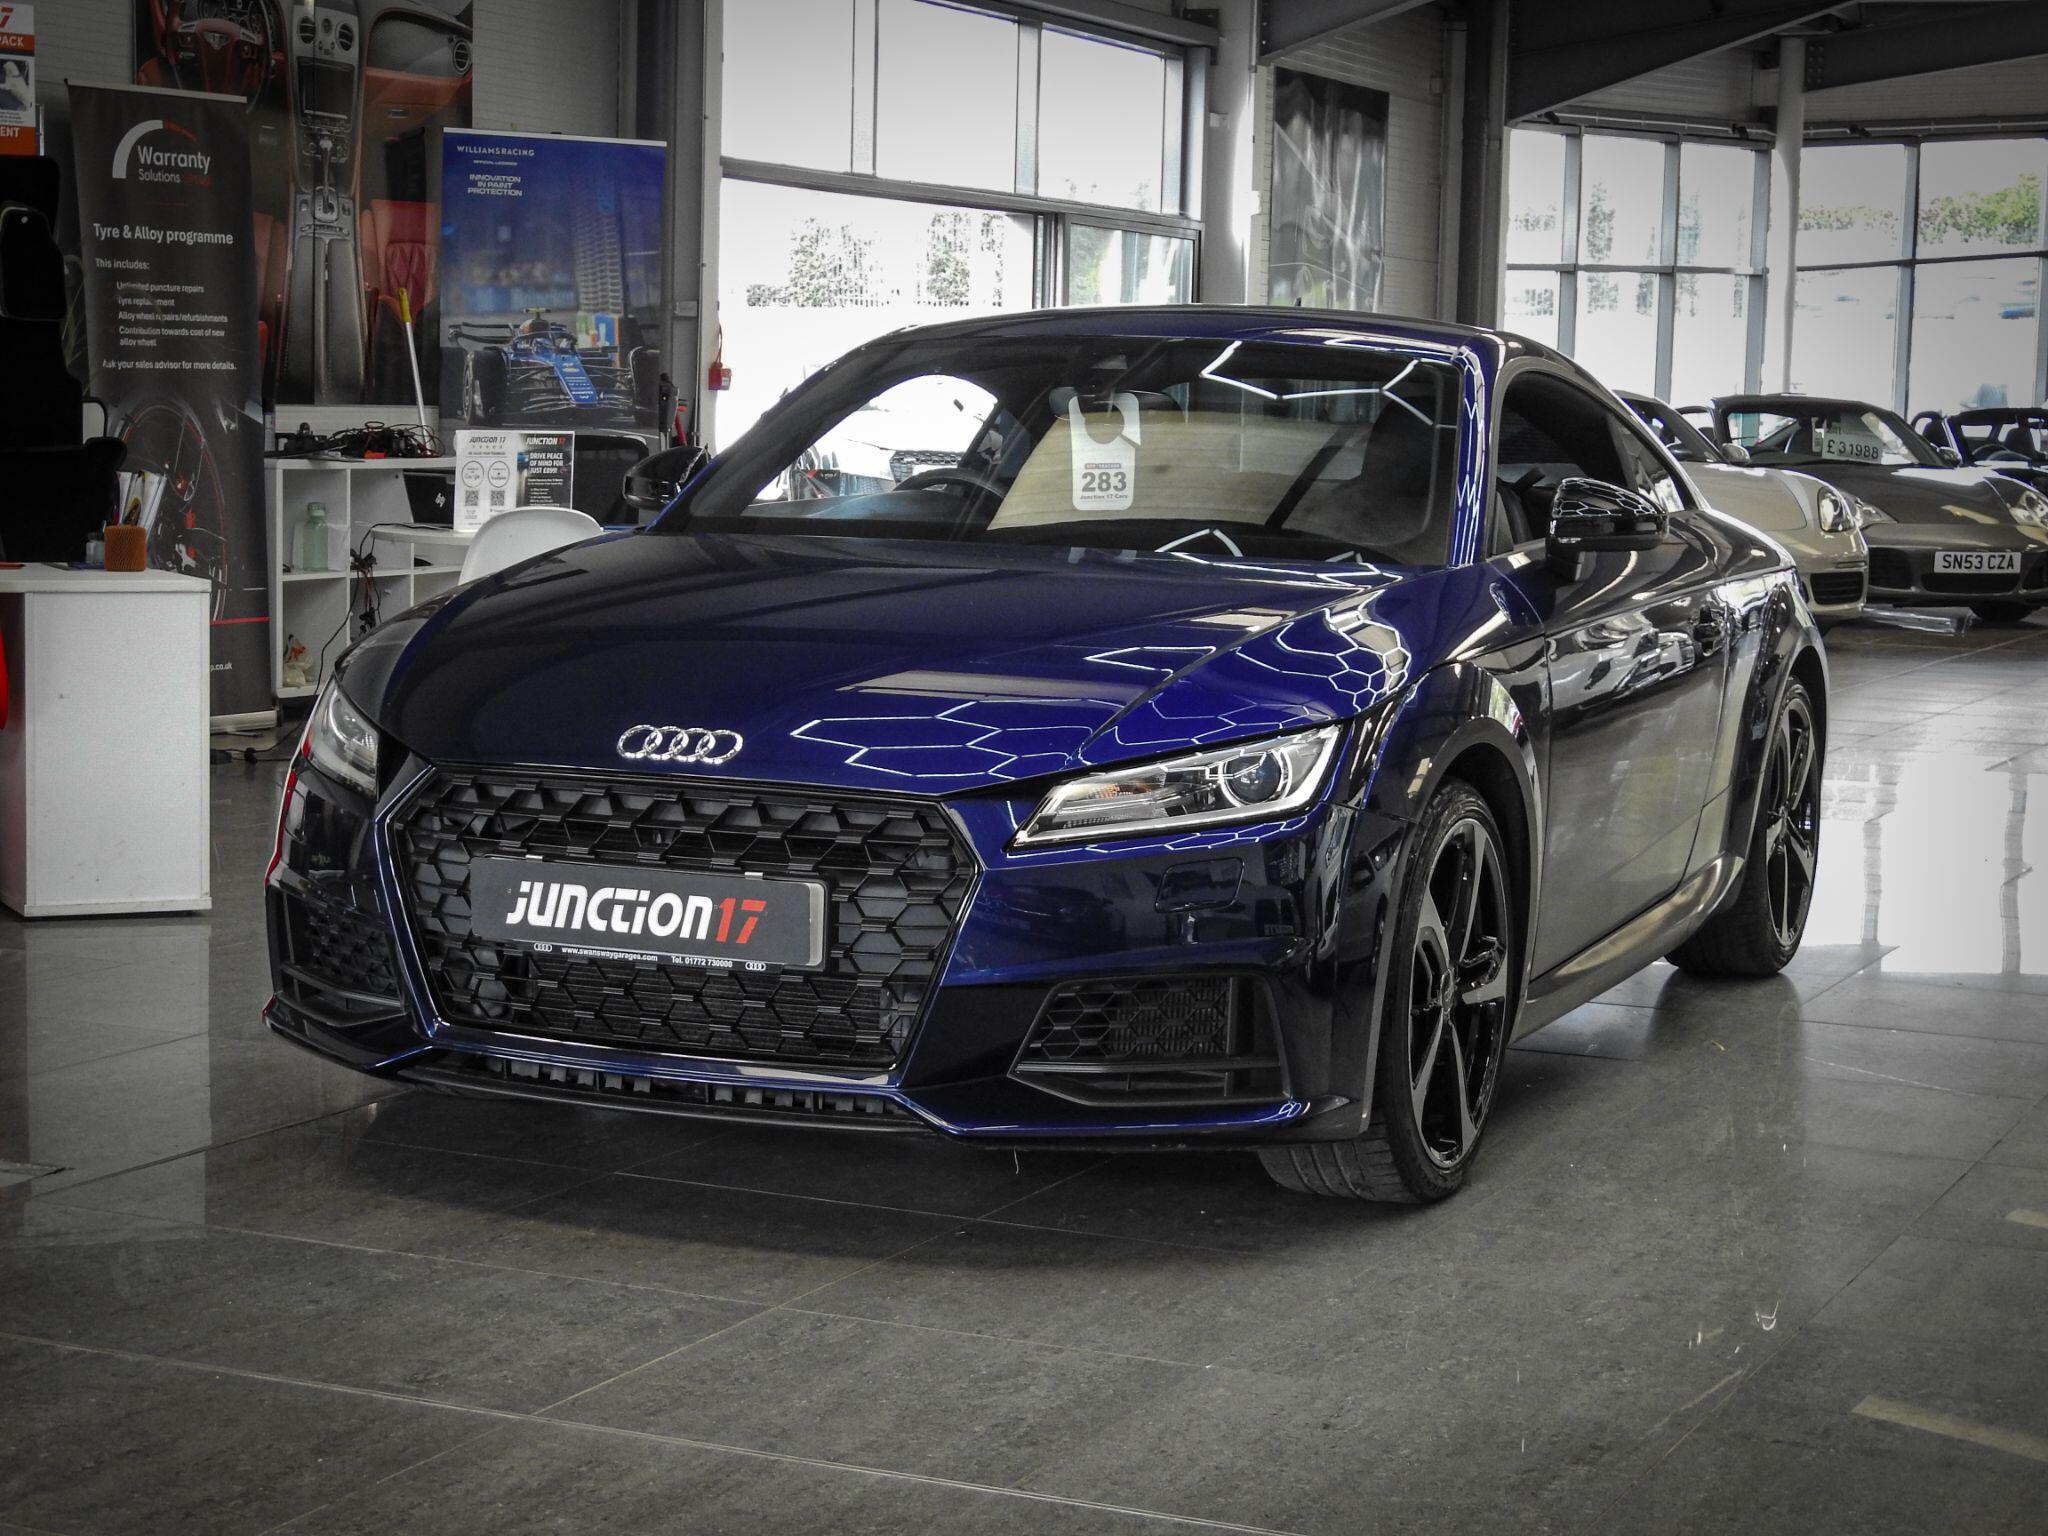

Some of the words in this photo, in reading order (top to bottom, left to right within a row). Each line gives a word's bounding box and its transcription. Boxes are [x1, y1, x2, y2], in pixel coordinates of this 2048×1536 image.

[138, 145, 211, 174] Warranty
[138, 168, 181, 183] Solutions
[469, 174, 521, 183] INNOVATION
[467, 188, 523, 196] PROTECTION
[93, 223, 120, 240] Tyre
[123, 224, 132, 239] &
[135, 226, 164, 243] Alloy
[166, 230, 234, 246] programme
[95, 258, 112, 268] This
[114, 259, 150, 269] includes:
[150, 283, 180, 293] puncture
[182, 283, 204, 294] repairs
[118, 312, 135, 322] Alloy
[136, 313, 155, 321] wheel
[119, 326, 161, 336] Contribution
[161, 328, 189, 336] towards
[190, 329, 204, 337] cost
[120, 338, 136, 347] alloy
[118, 361, 133, 370] your
[135, 360, 153, 369] sales
[154, 361, 182, 370] advisor
[182, 361, 192, 369] for
[193, 362, 211, 370] more
[526, 437, 558, 445] JUNCTION
[1082, 471, 1127, 492] 283
[1942, 555, 1983, 570] SN53
[1988, 555, 2014, 570] CZA
[561, 946, 658, 962] www.swanswaygarages.com
[671, 955, 683, 964] Tel.
[684, 957, 706, 966] 01772
[708, 958, 733, 968] 730000
